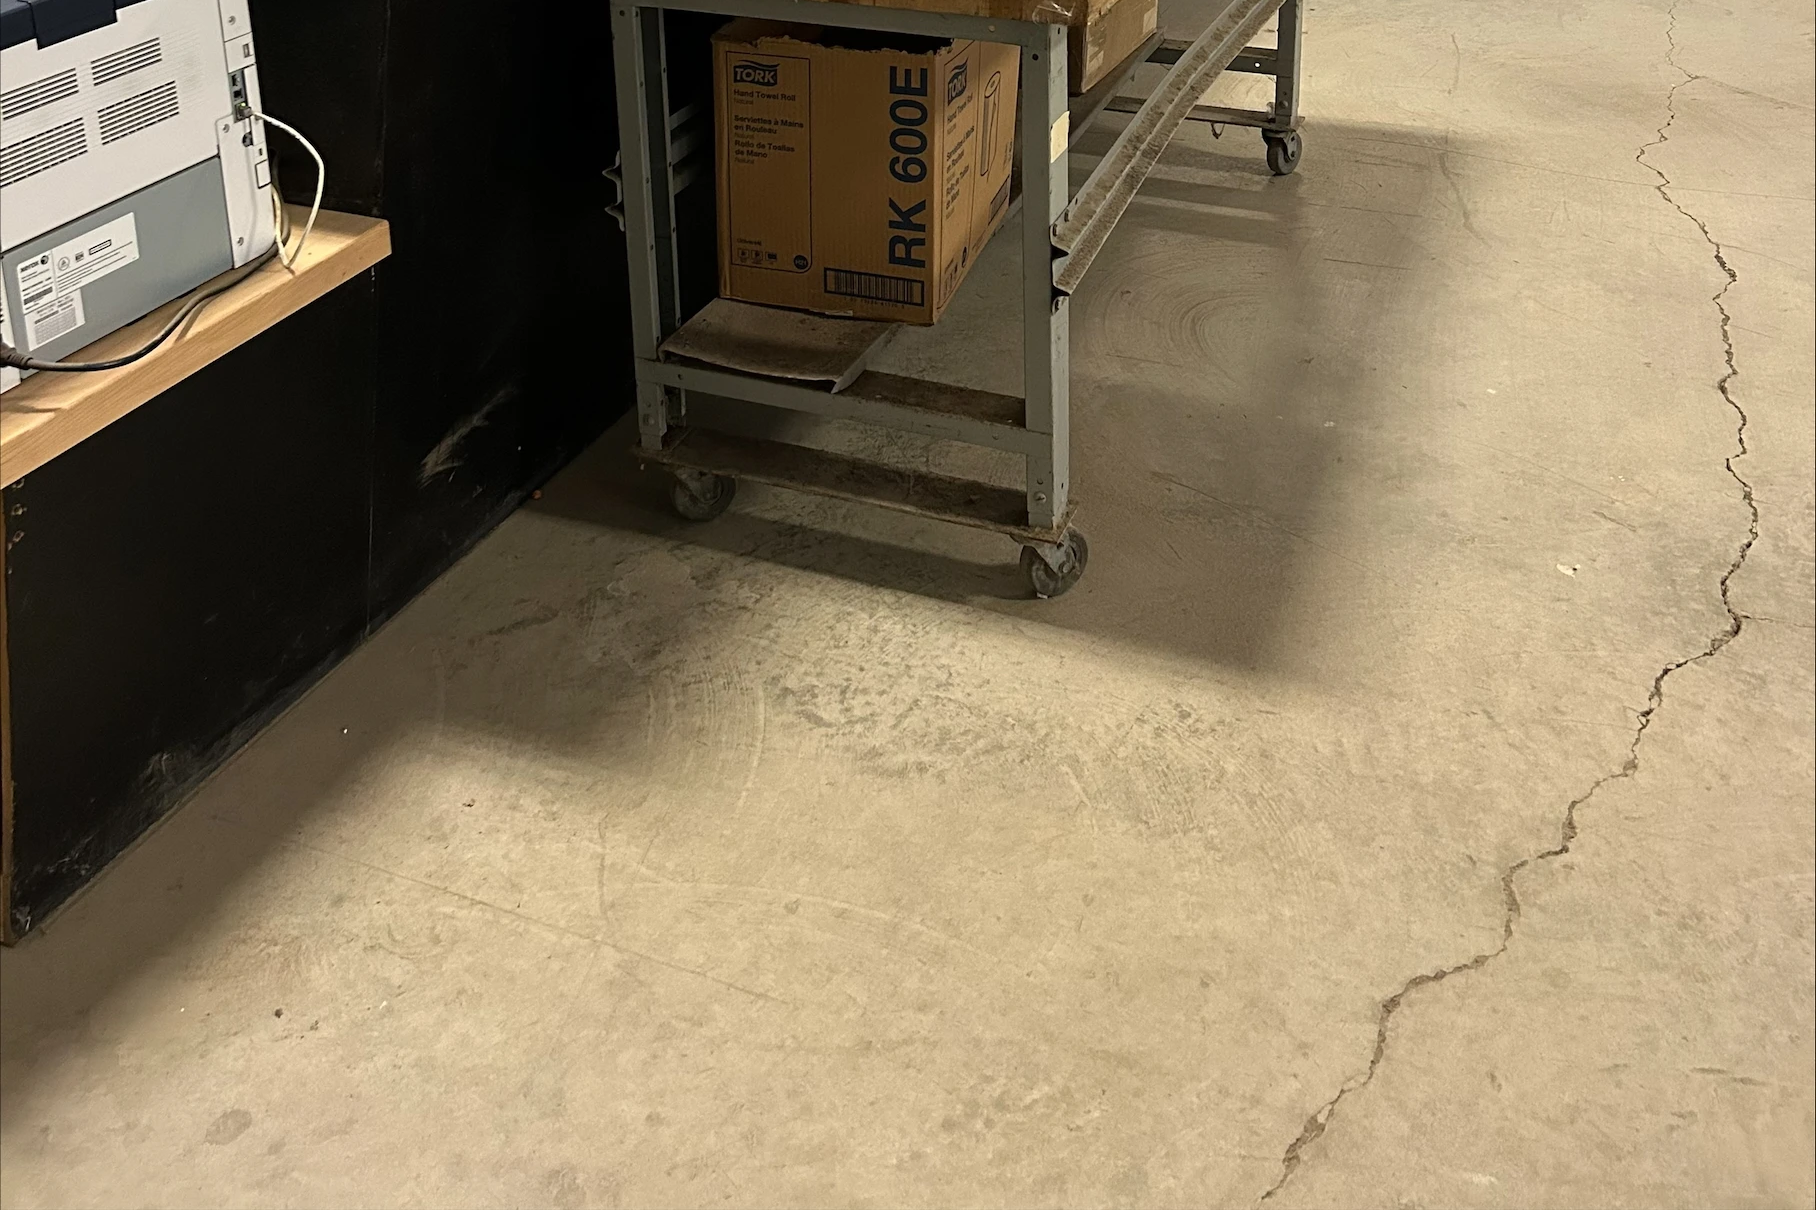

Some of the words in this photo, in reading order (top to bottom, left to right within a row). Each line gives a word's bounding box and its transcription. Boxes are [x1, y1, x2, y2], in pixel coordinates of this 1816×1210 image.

[734, 68, 775, 83] TORK
[948, 68, 967, 99] TORK
[733, 89, 754, 98] Hand
[755, 91, 779, 100] Towel
[780, 93, 796, 102] Roll
[733, 115, 772, 125] Serviettes
[780, 119, 804, 128] Mains
[889, 65, 929, 183] 600E
[745, 124, 777, 134] Rouleau
[734, 140, 755, 148] Rollo
[767, 143, 796, 152] Toallas
[746, 150, 768, 158] Mano
[888, 197, 927, 268] RK
